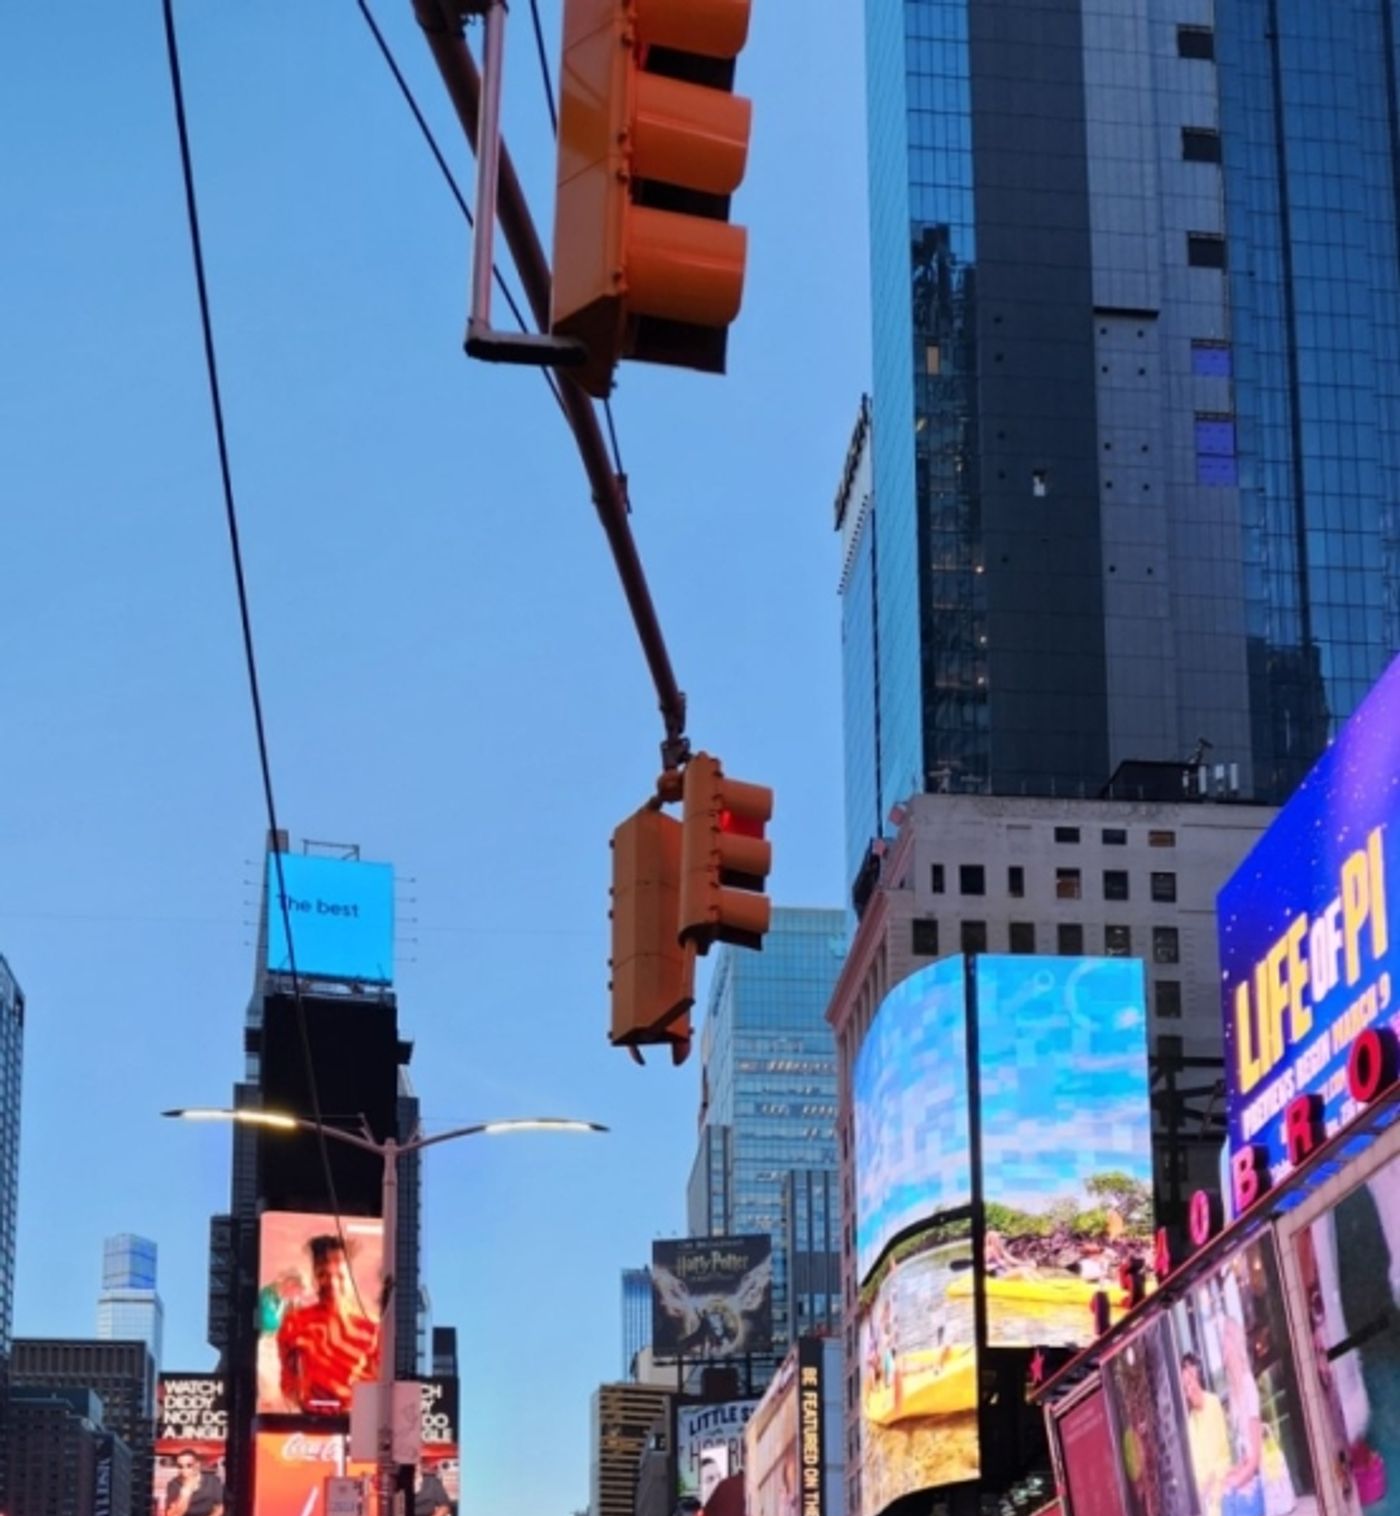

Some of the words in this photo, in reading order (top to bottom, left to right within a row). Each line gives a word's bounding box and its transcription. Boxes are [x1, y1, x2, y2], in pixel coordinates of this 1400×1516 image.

[277, 892, 312, 912] The
[316, 898, 359, 918] best
[1234, 911, 1313, 1096] LIFE
[1309, 896, 1343, 1003] OF
[1340, 825, 1389, 988] PI
[802, 1366, 818, 1387] BE
[164, 1380, 223, 1396] WATCH
[164, 1395, 216, 1410] DIDDY
[164, 1409, 200, 1425] NOT
[689, 1406, 738, 1437] LITTLE
[803, 1391, 819, 1465] FEATURED
[803, 1467, 820, 1489] ON
